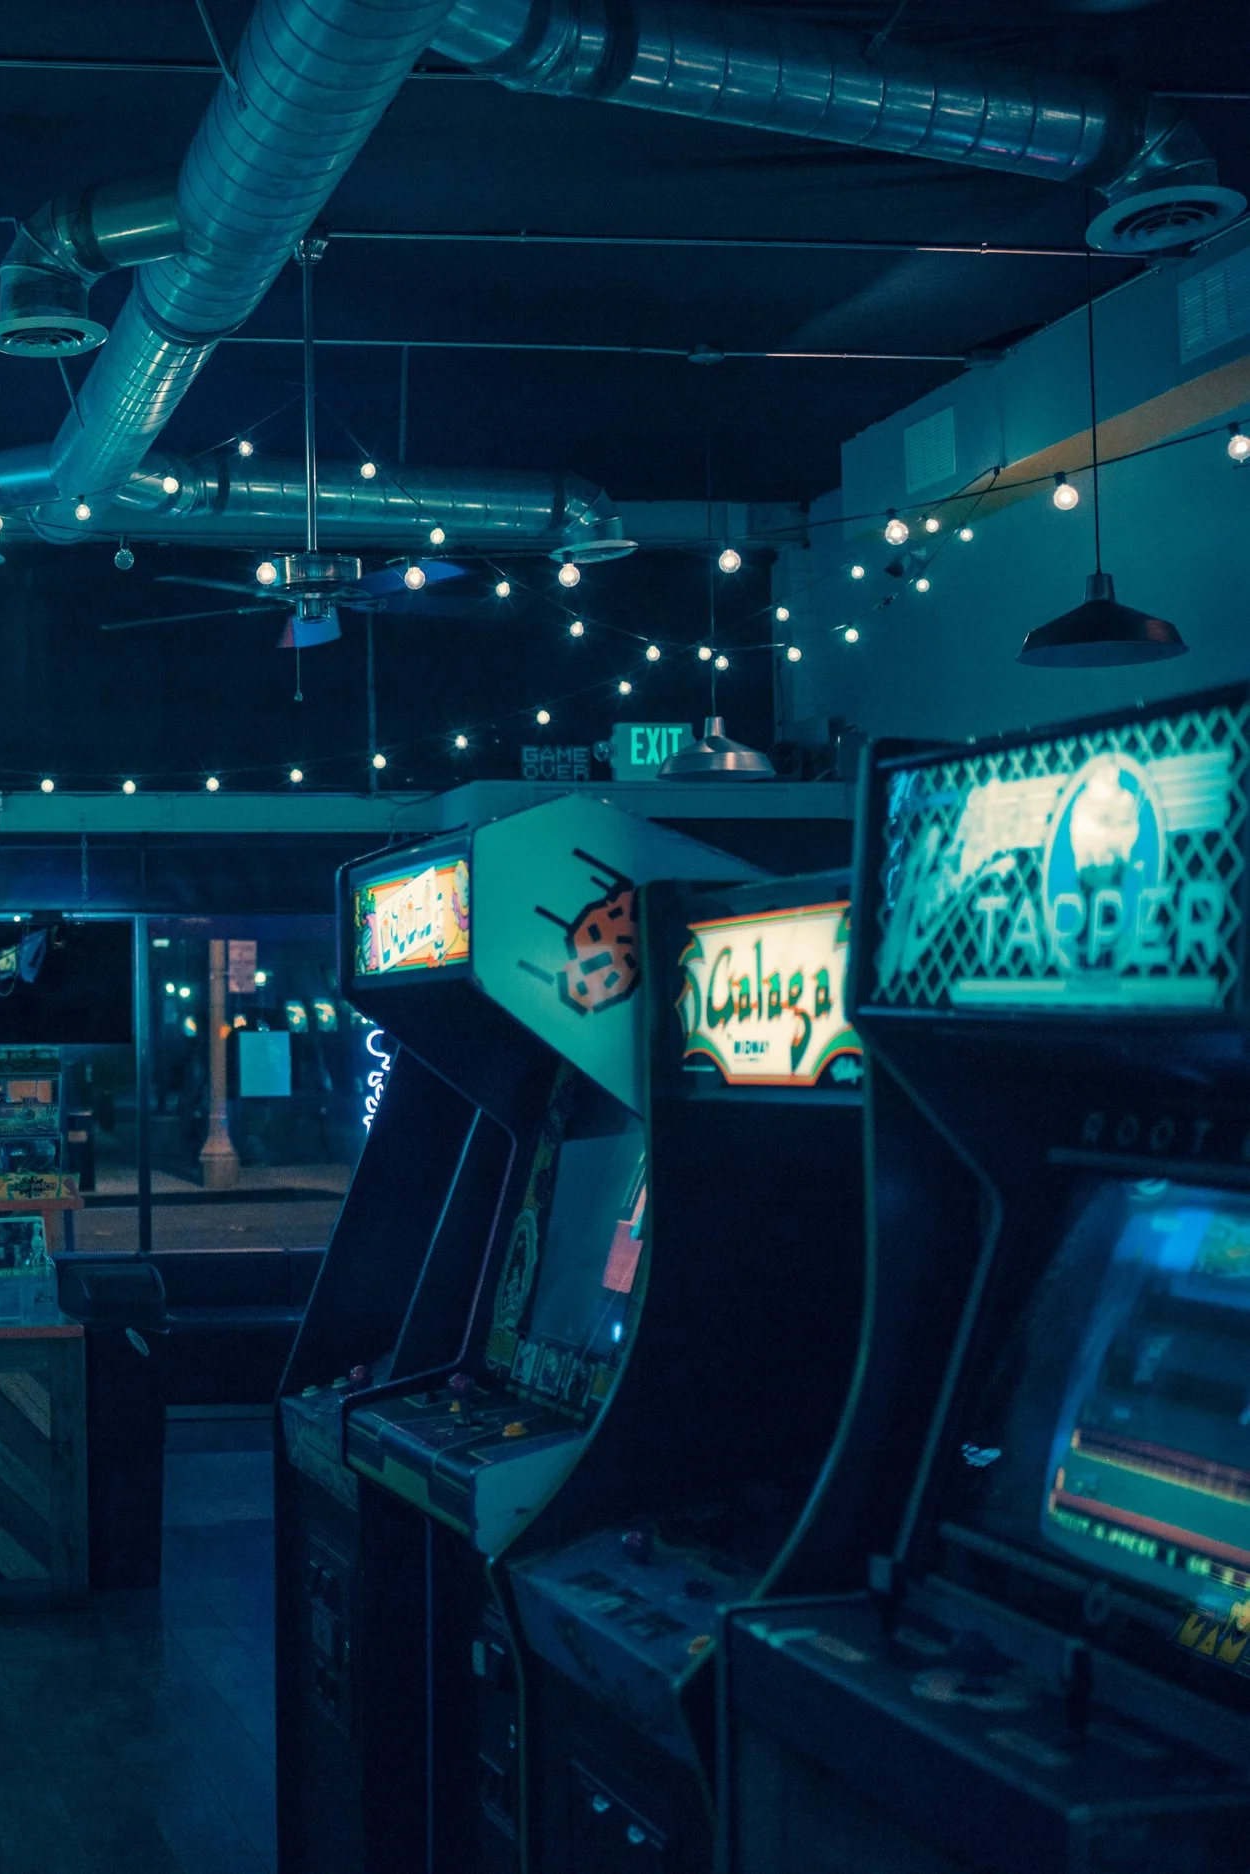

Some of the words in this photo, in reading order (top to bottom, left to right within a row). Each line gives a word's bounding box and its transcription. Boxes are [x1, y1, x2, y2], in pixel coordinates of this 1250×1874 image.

[522, 746, 589, 763] GAME
[631, 727, 683, 765] EXIT
[522, 764, 590, 780] OVER
[976, 880, 1226, 969] TAPPER
[706, 935, 834, 1075] Galaga
[1082, 1108, 1215, 1152] ROOT
